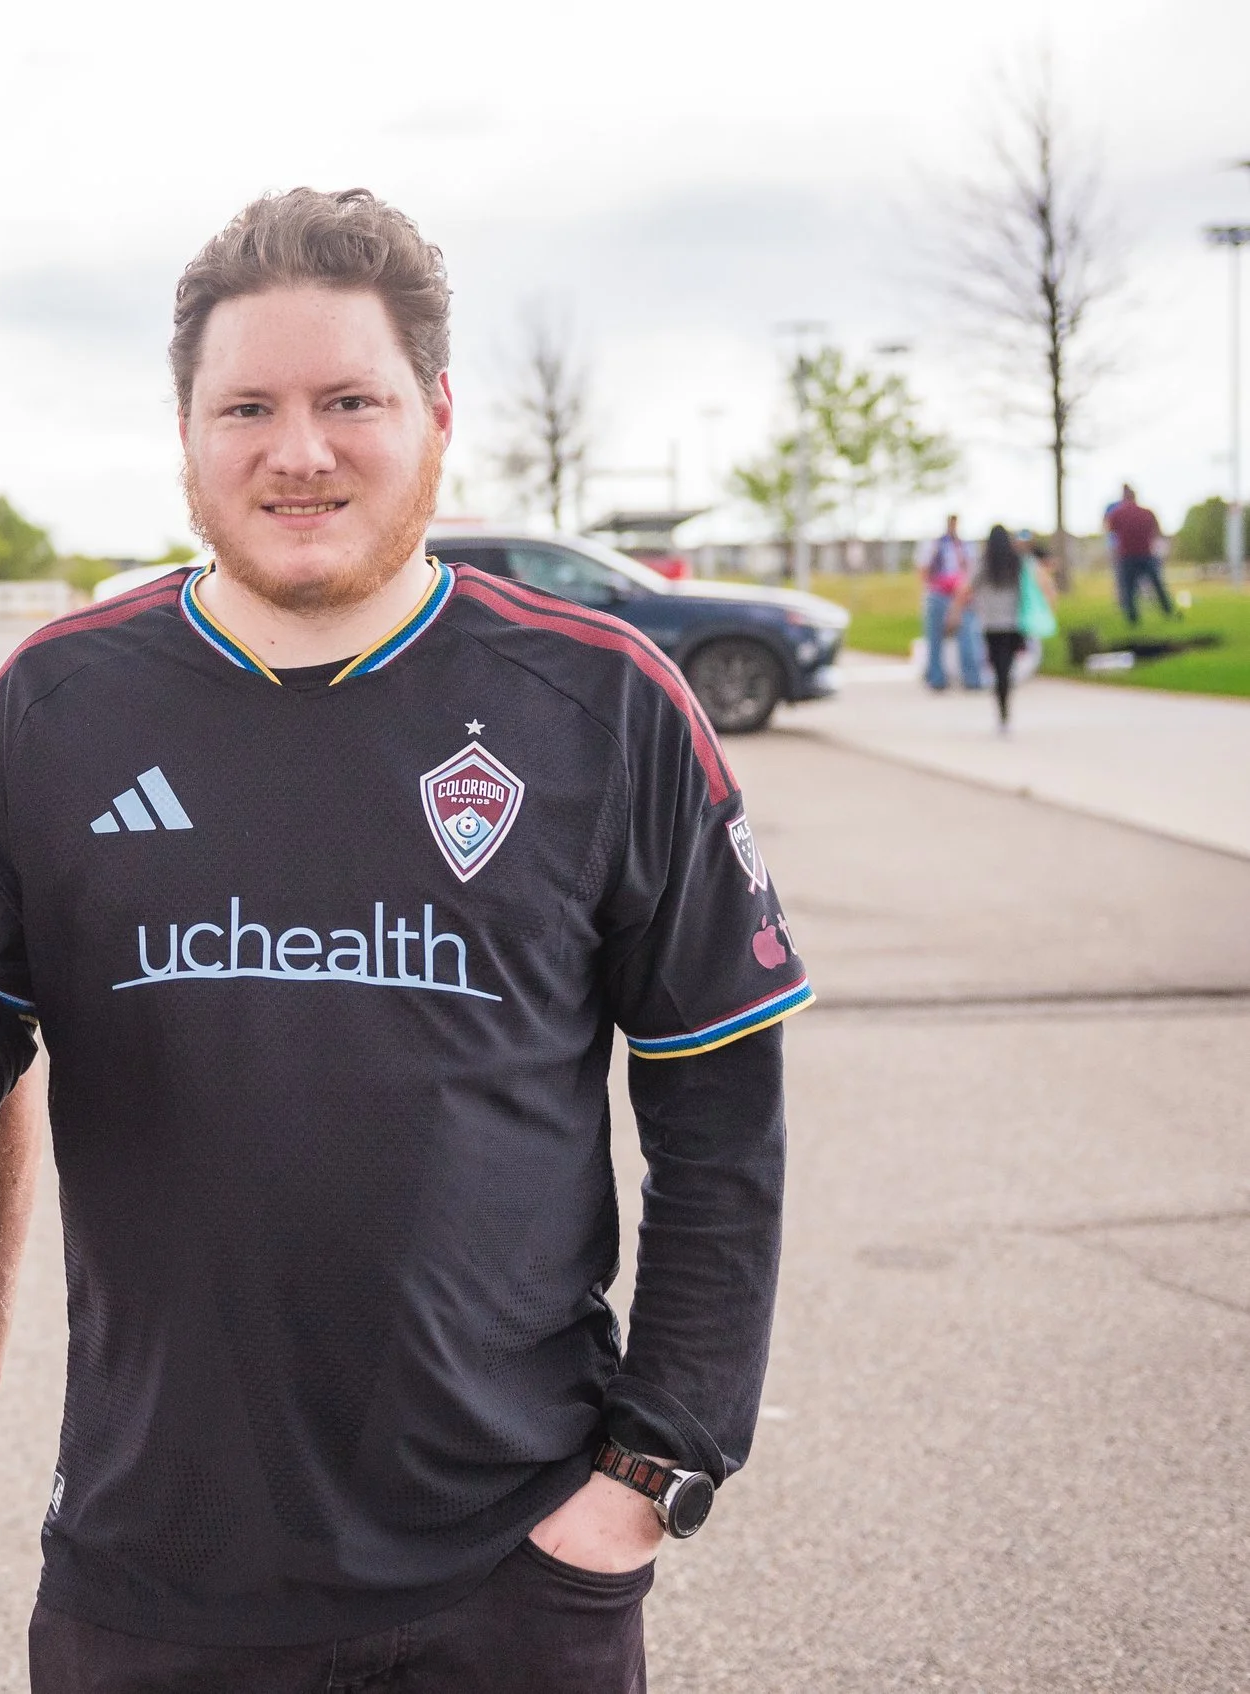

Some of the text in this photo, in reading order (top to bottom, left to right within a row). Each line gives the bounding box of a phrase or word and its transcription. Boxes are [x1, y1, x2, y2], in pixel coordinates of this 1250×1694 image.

[438, 779, 504, 802] COLORADO
[451, 796, 490, 804] RAPIDS
[137, 896, 468, 991] uchealth
